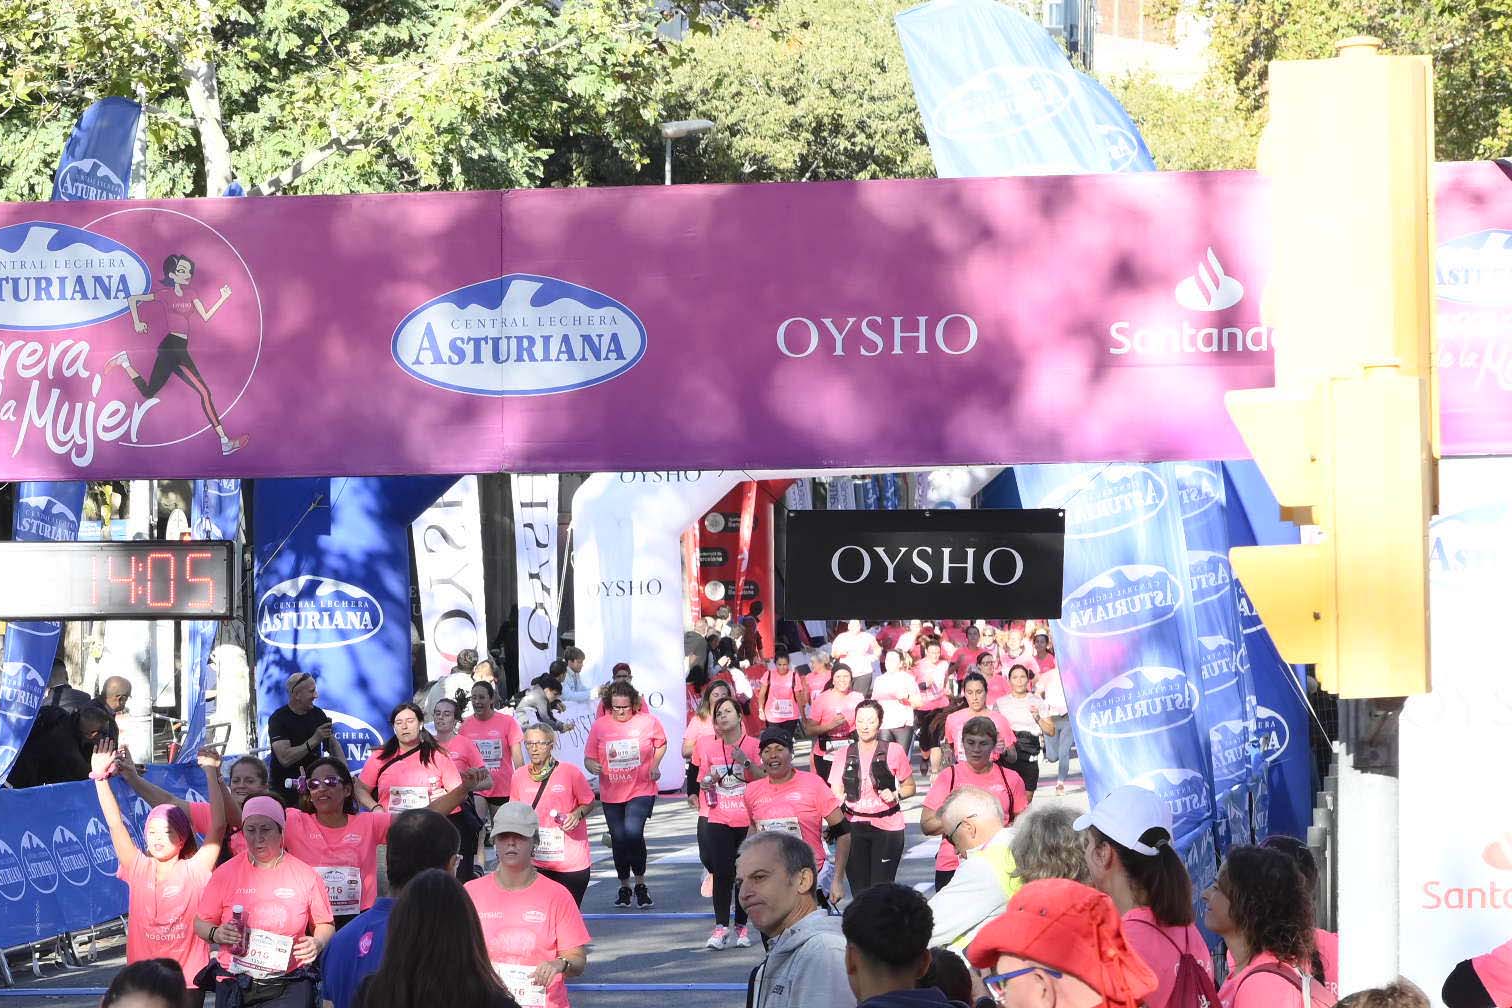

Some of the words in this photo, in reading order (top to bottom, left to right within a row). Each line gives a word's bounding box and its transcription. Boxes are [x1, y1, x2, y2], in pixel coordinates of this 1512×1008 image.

[54, 258, 126, 269] LECHERA
[451, 317, 529, 330] CENTRAL
[538, 314, 619, 328] LECHERA
[777, 313, 979, 358] OYSHO
[411, 322, 628, 366] ASTURIANA
[11, 376, 161, 467] Mujer
[92, 553, 213, 607] 14:05
[830, 545, 1024, 586] OYSHO
[261, 605, 373, 632] ASTURIANA
[320, 600, 369, 608] LECHERA
